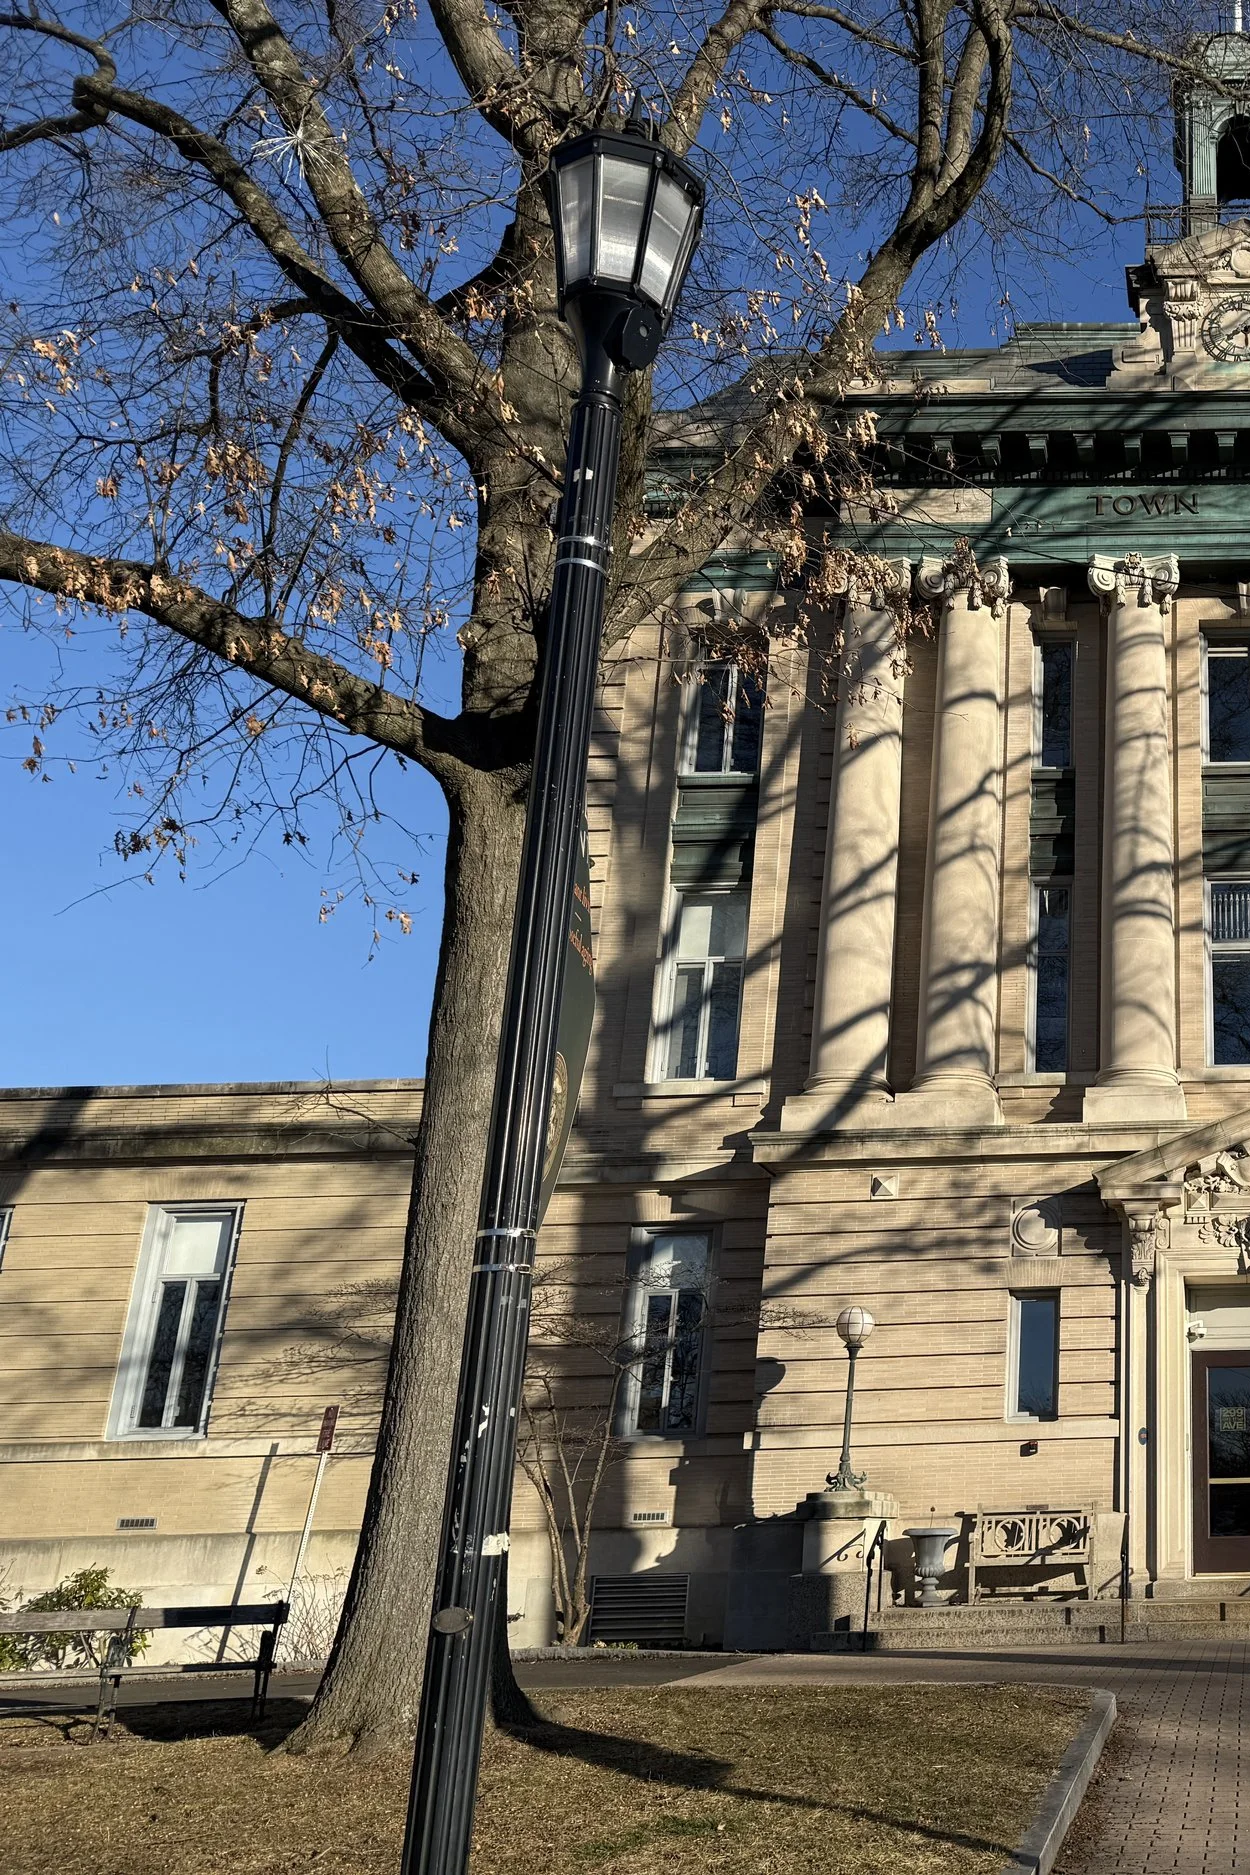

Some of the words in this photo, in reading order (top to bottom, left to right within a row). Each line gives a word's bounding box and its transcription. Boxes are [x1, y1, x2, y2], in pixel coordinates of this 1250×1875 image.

[1086, 492, 1200, 516] TOWN
[1222, 1408, 1244, 1417] 299
[1222, 1421, 1244, 1430] AVE
